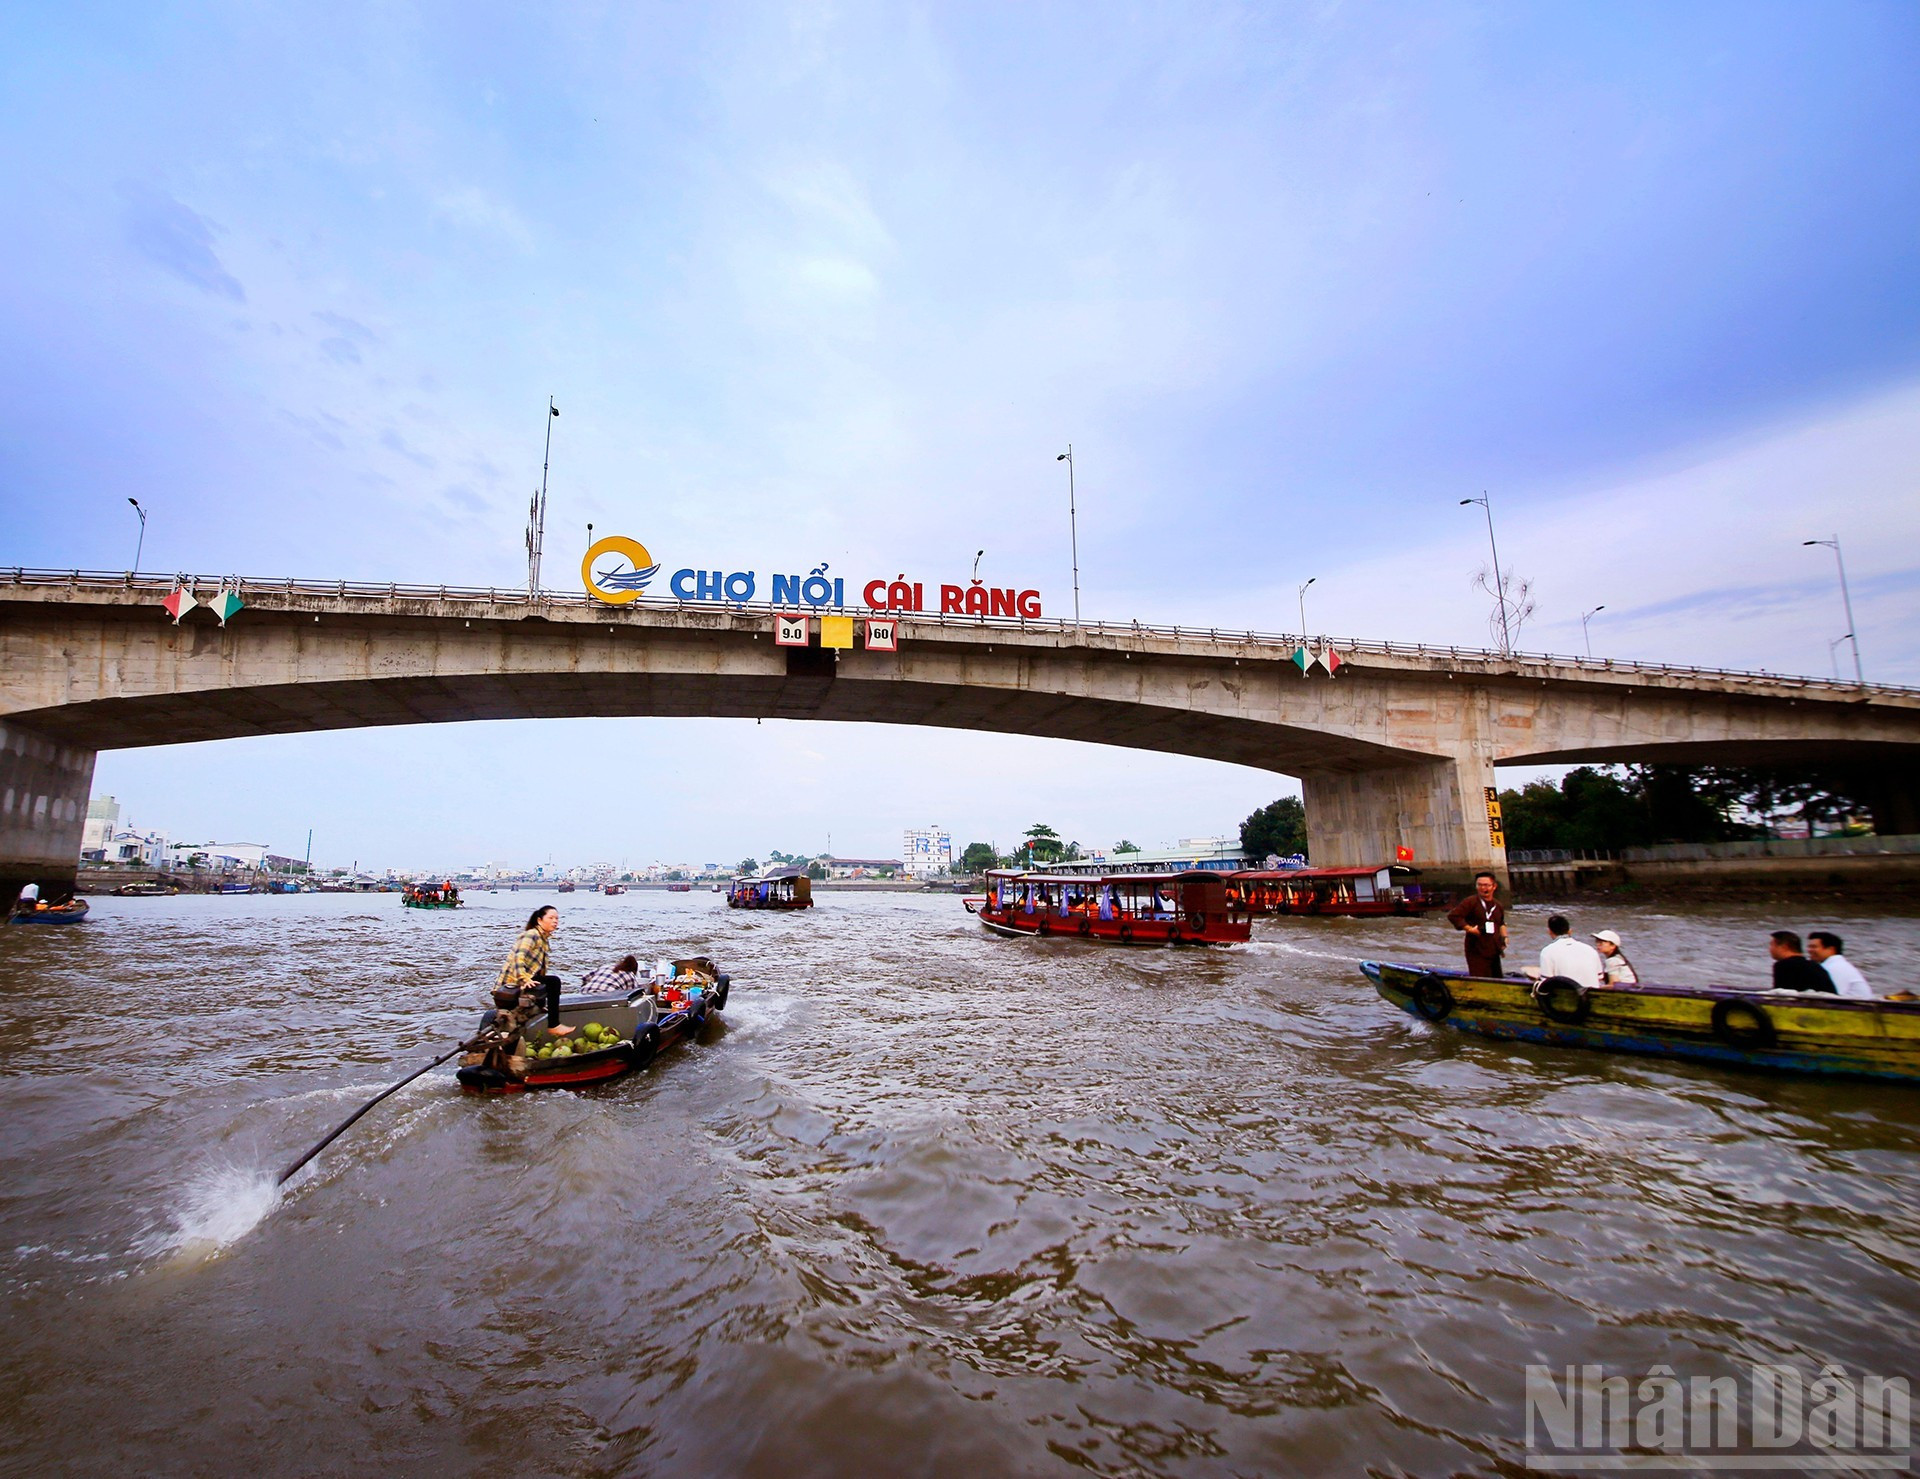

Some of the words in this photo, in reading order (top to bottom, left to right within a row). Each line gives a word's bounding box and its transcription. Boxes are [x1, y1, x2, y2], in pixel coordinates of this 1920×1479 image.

[670, 568, 756, 610] CHỢ
[772, 562, 844, 607] NỔI
[863, 573, 923, 612] CÁI
[940, 579, 1042, 619] RĂNG
[782, 627, 802, 640] 9.0
[873, 628, 889, 640] 60
[1489, 790, 1495, 800] 3
[1491, 805, 1497, 814] 4
[1493, 819, 1499, 830] 5
[1495, 835, 1501, 845] 6
